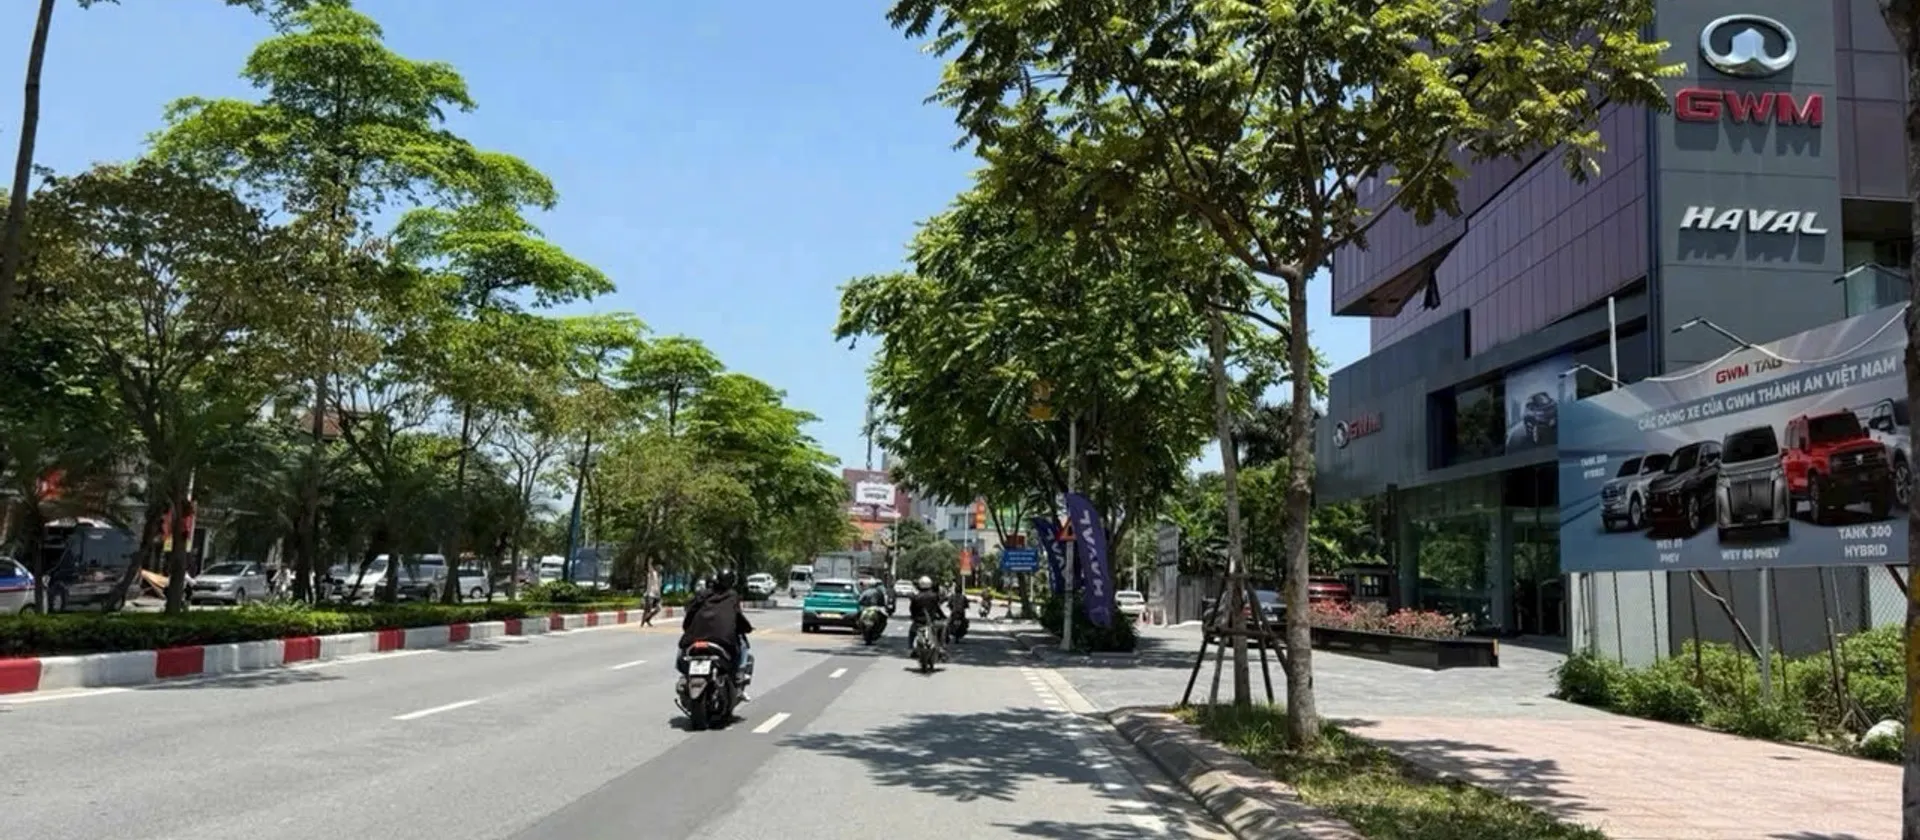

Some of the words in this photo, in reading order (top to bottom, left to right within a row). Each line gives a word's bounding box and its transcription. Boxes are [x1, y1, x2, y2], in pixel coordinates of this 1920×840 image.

[1676, 88, 1824, 125] GWM
[1680, 206, 1828, 234] HAVAL
[1686, 405, 1700, 420] XE
[1702, 397, 1725, 416] CỦA
[1726, 391, 1755, 410] GWM
[1757, 380, 1801, 403] THÀNH
[1803, 374, 1823, 393] AN
[1826, 363, 1859, 388] VIỆT
[1861, 356, 1897, 379] NAM
[1716, 364, 1749, 384] GWM
[1838, 525, 1868, 540] TANK
[1870, 524, 1893, 538] 300
[1080, 509, 1105, 596] HAVAL
[1844, 543, 1888, 558] HYBRID
